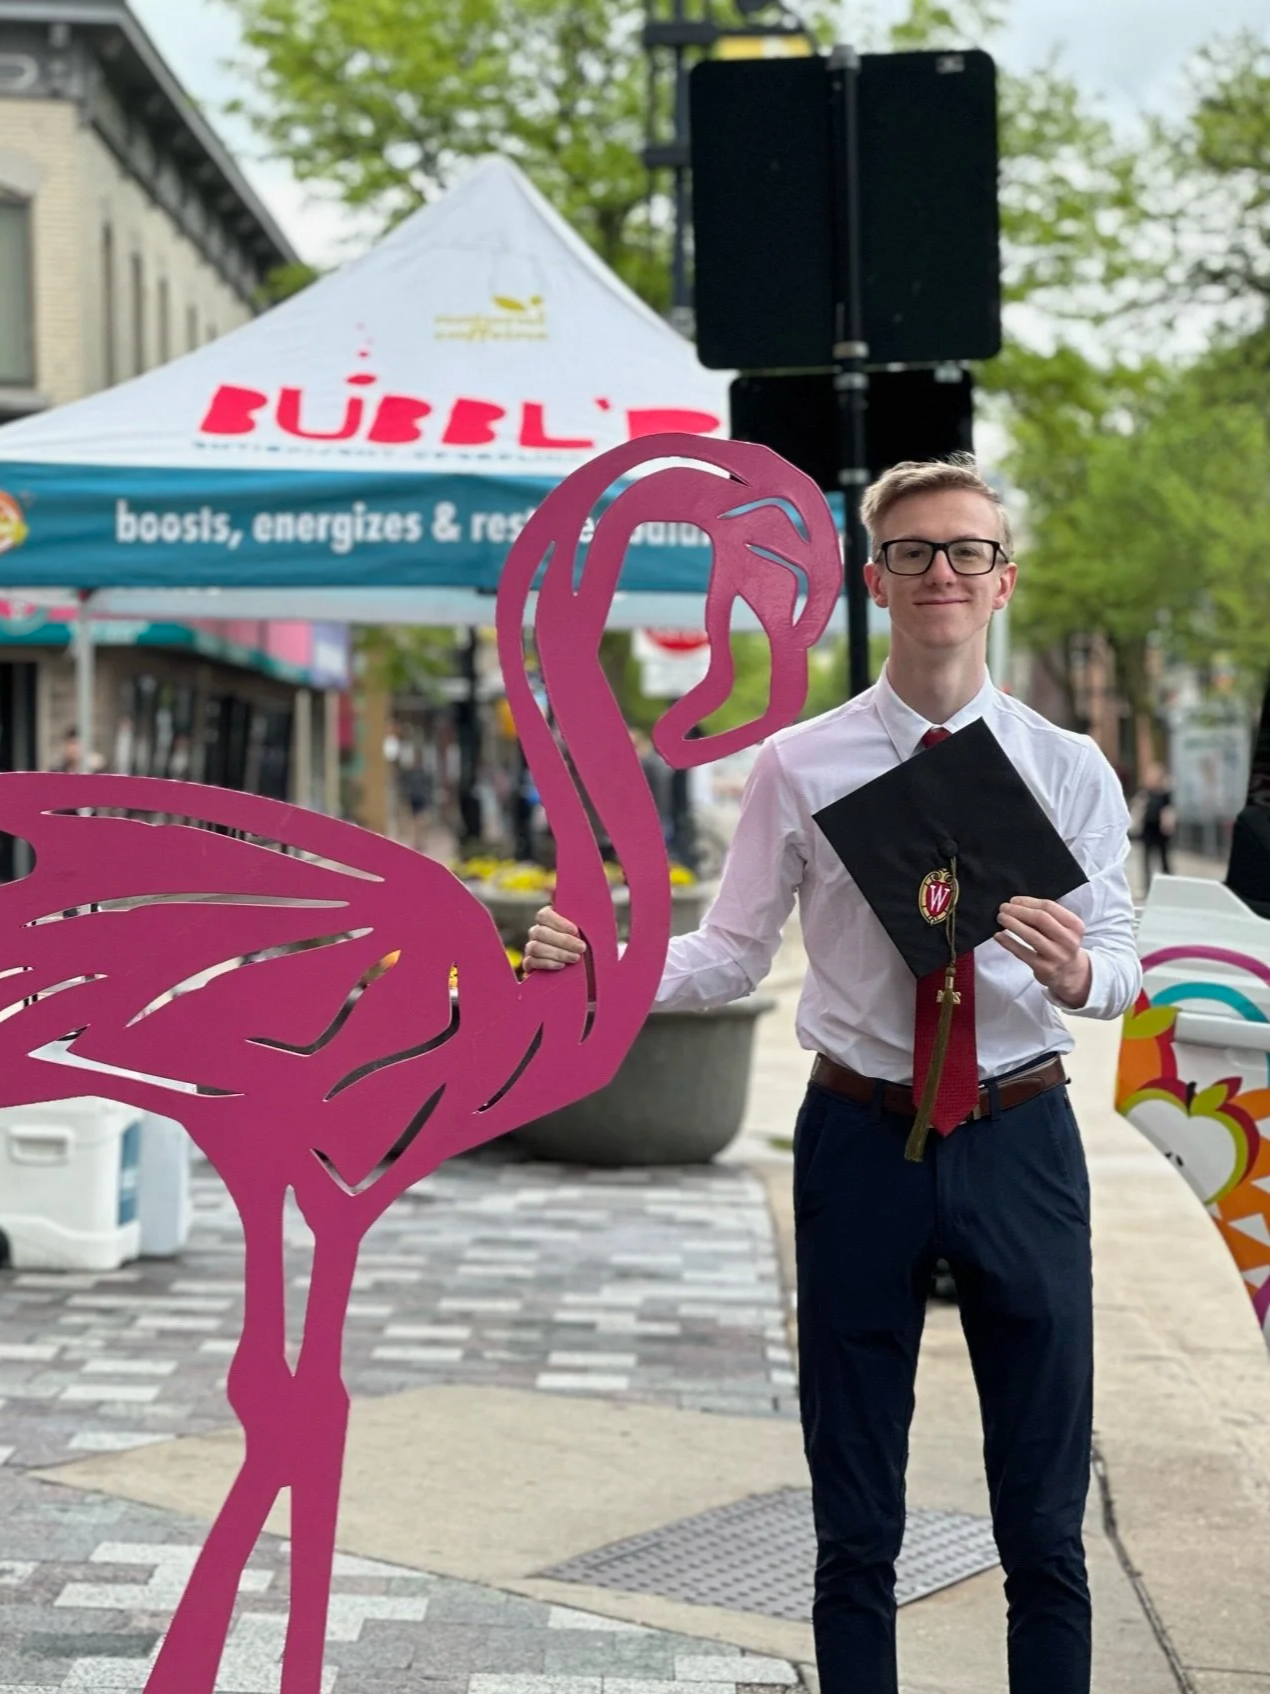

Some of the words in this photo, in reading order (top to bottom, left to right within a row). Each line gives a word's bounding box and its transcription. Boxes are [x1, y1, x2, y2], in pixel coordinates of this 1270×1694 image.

[116, 499, 244, 551] boosts,
[252, 501, 423, 555] energizes
[432, 501, 461, 543] &
[930, 884, 951, 912] W
